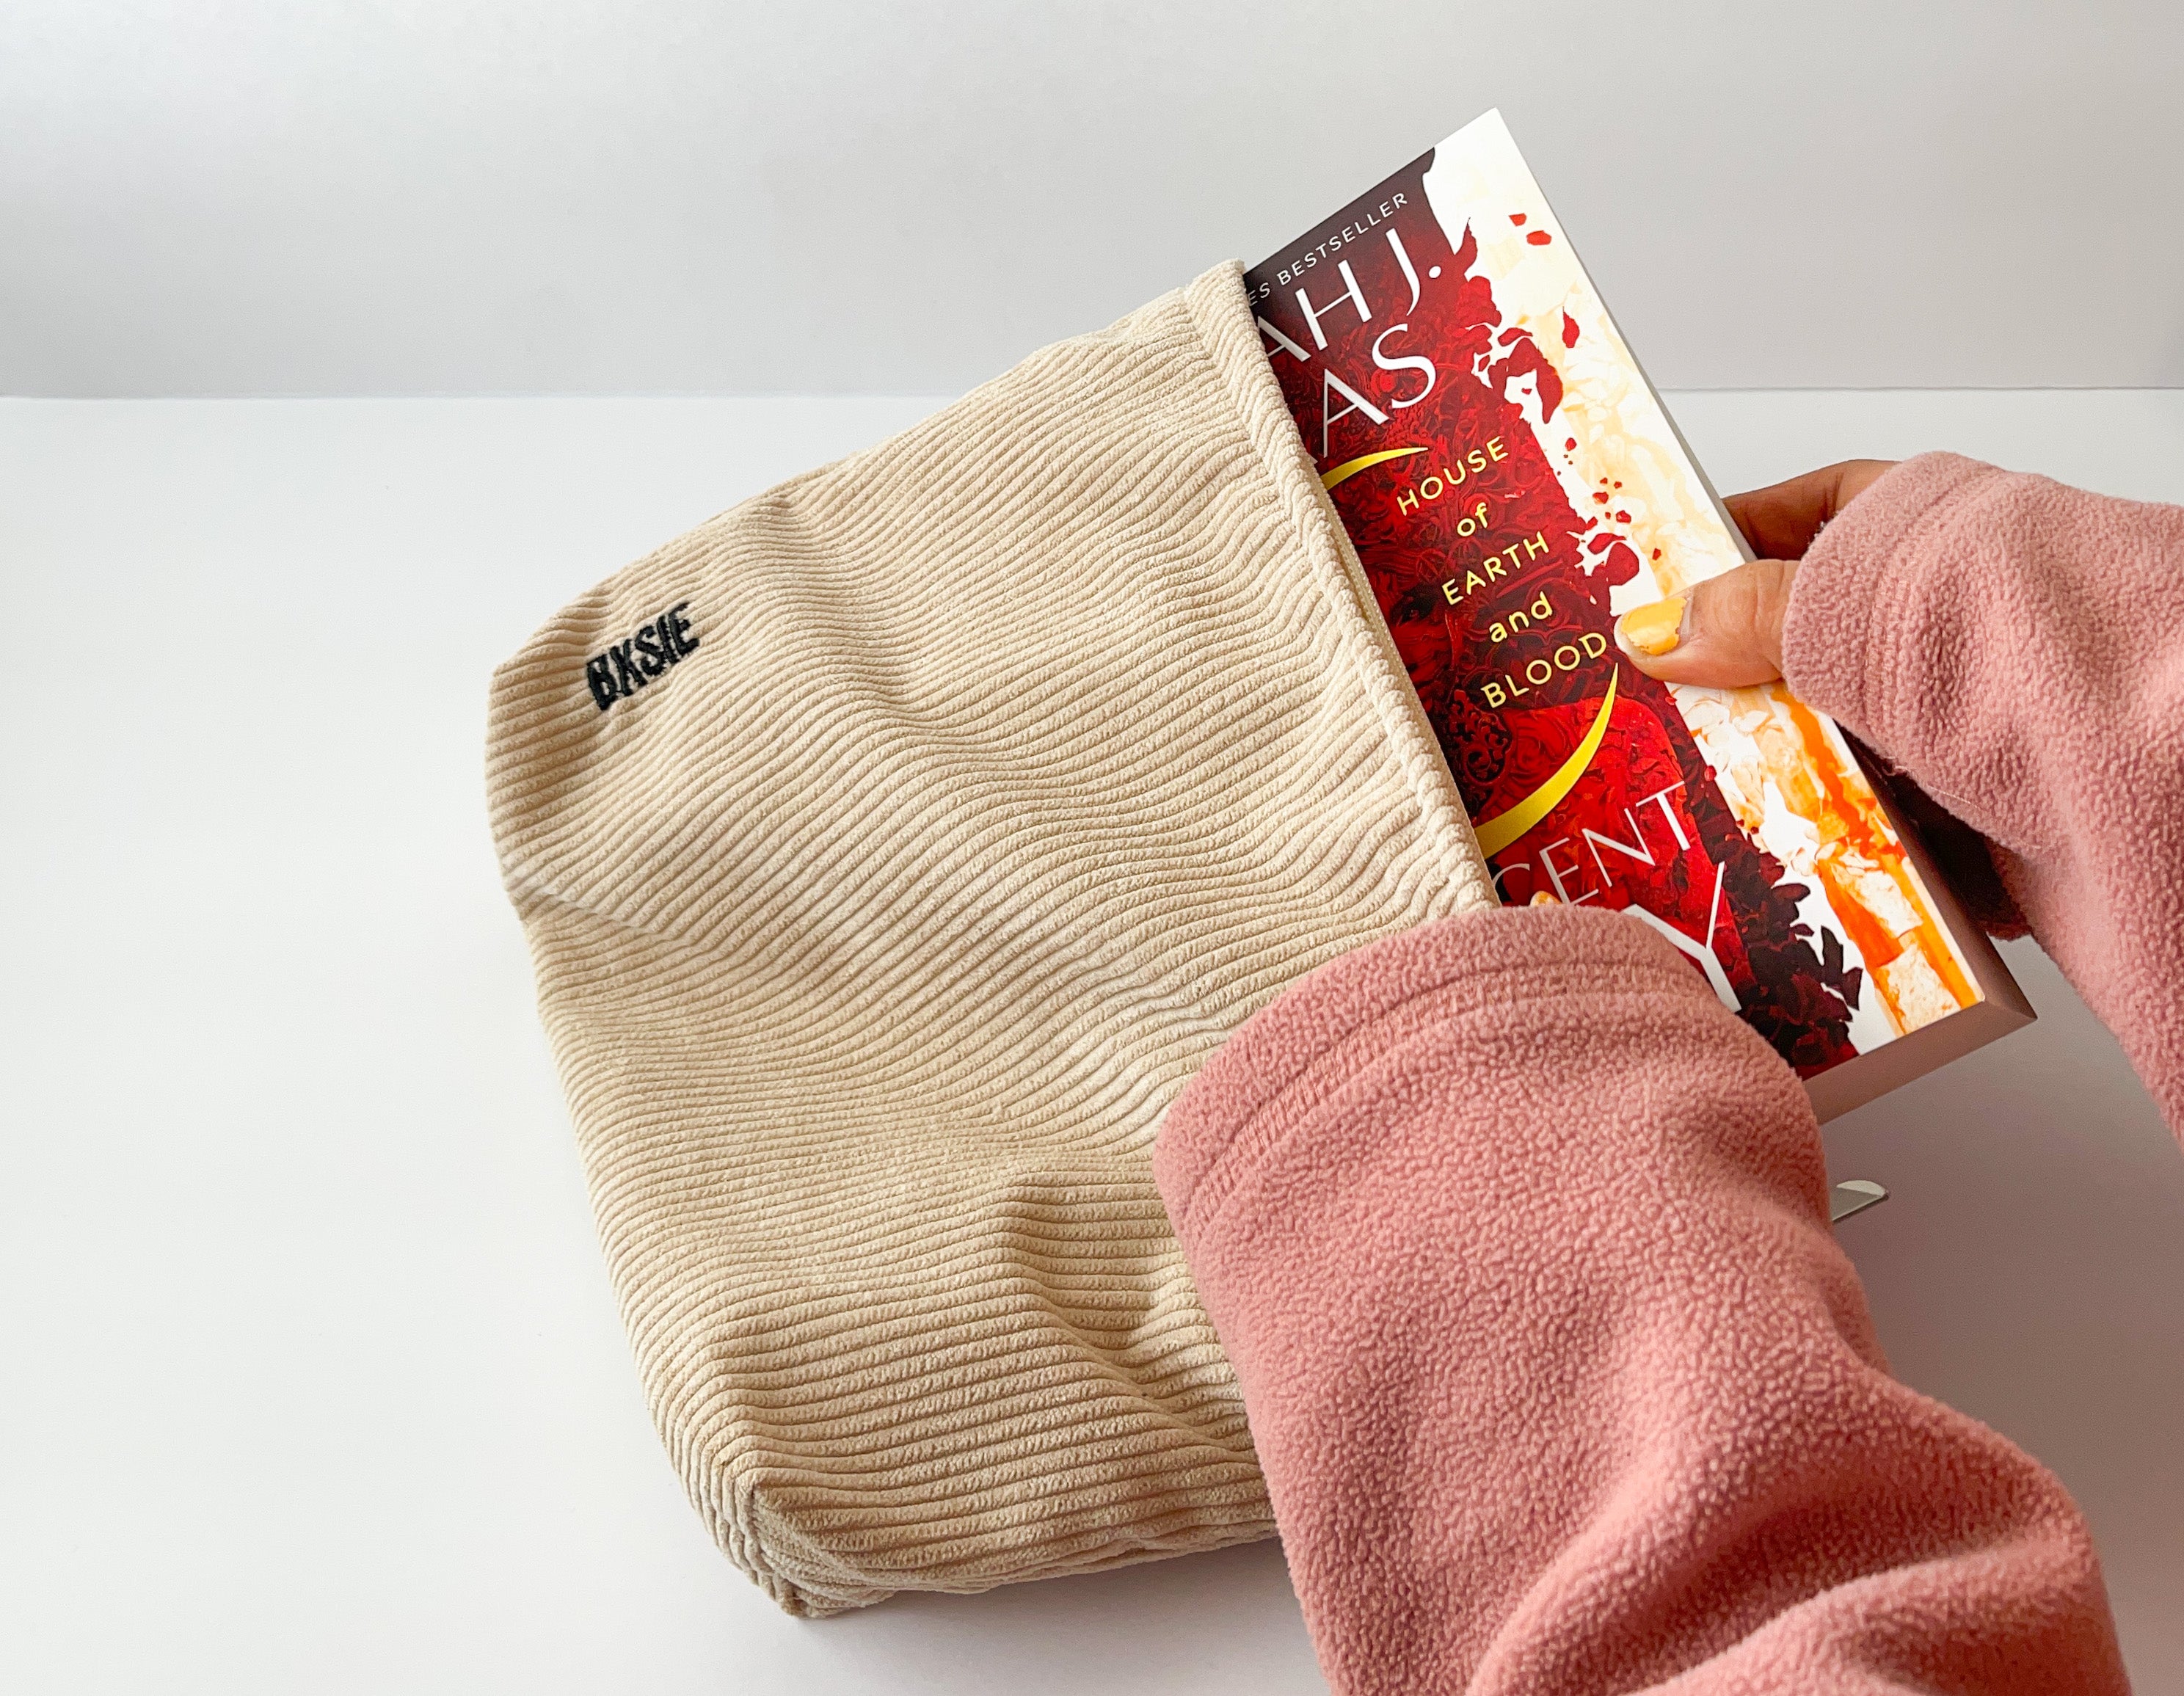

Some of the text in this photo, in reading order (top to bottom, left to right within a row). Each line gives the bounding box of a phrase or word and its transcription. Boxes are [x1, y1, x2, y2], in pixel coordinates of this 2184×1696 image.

[1277, 192, 1408, 285] BESTSELLER
[1386, 228, 1441, 316] J.
[1309, 324, 1436, 464] AS
[1397, 436, 1508, 516] HOUSE
[1457, 502, 1489, 537] of
[1441, 531, 1550, 605] EARTH
[586, 601, 700, 711] BKSIE
[1488, 592, 1553, 643] and
[1480, 632, 1607, 708] BLOOD
